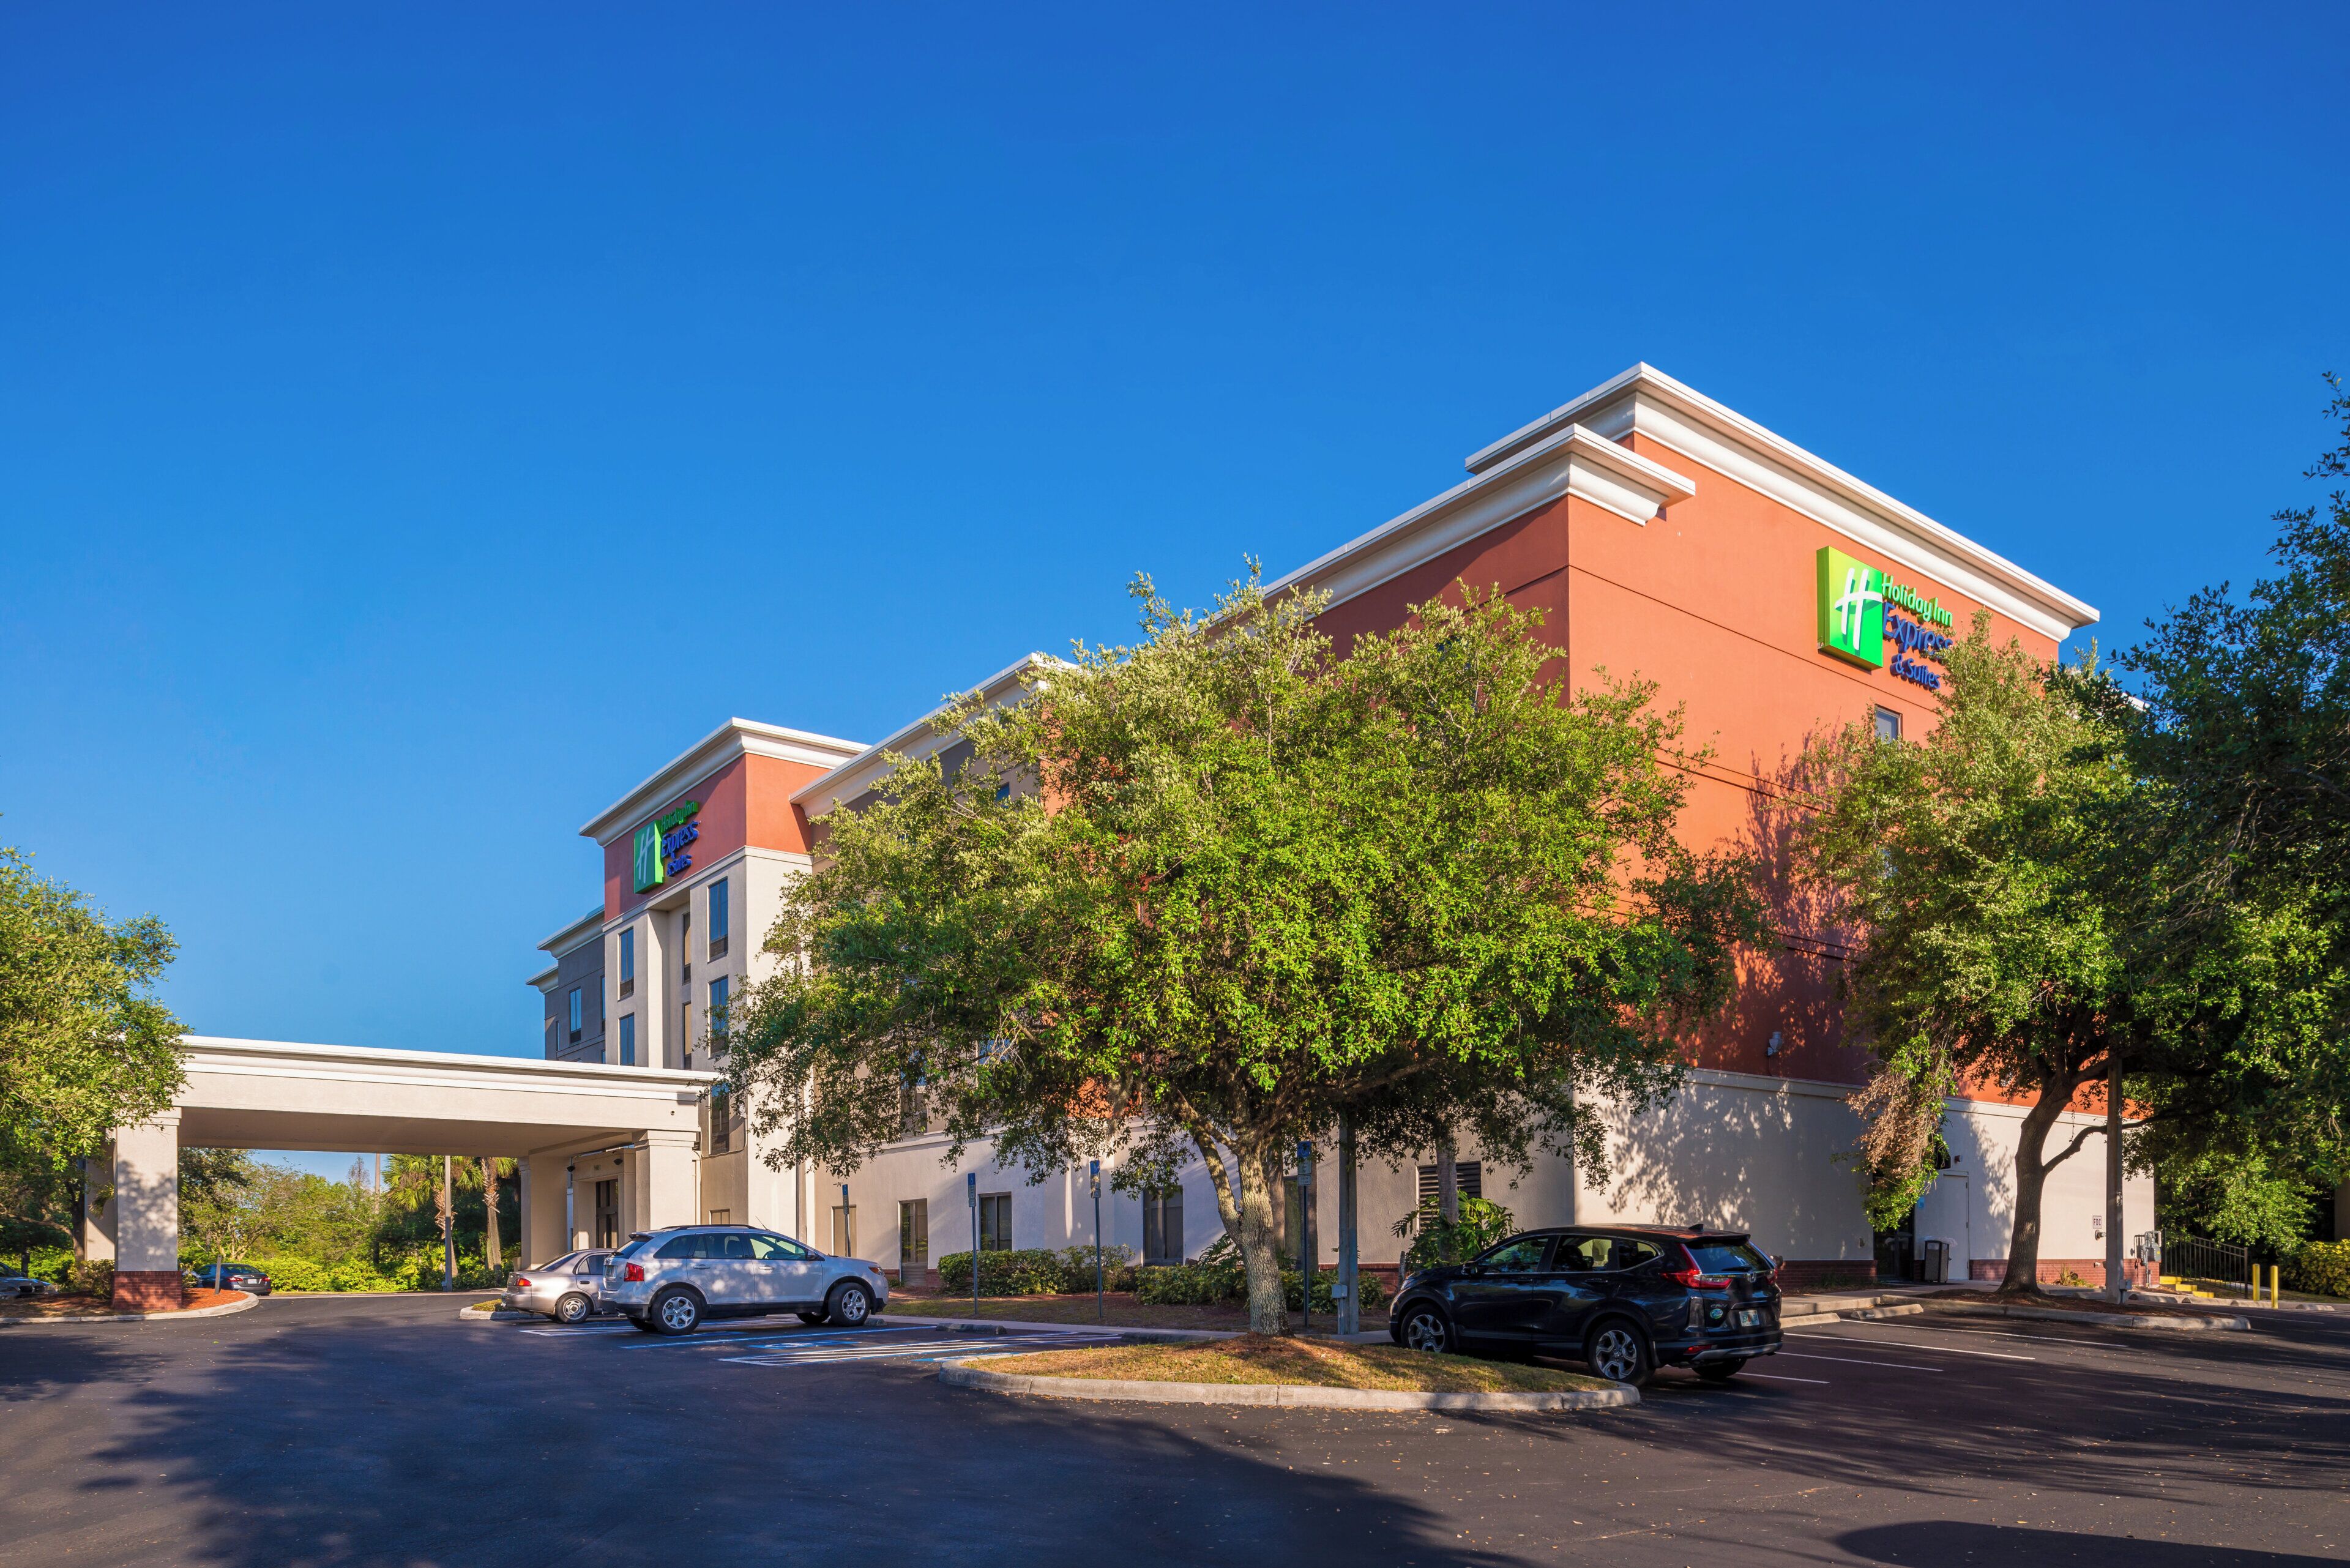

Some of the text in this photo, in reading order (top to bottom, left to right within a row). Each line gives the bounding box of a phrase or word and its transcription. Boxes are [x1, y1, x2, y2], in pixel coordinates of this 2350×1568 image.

[1882, 572, 1953, 627] Holiday Inn
[1895, 653, 1941, 689] & Suites
[661, 800, 696, 833] Holiday Inn
[661, 821, 699, 859] Express
